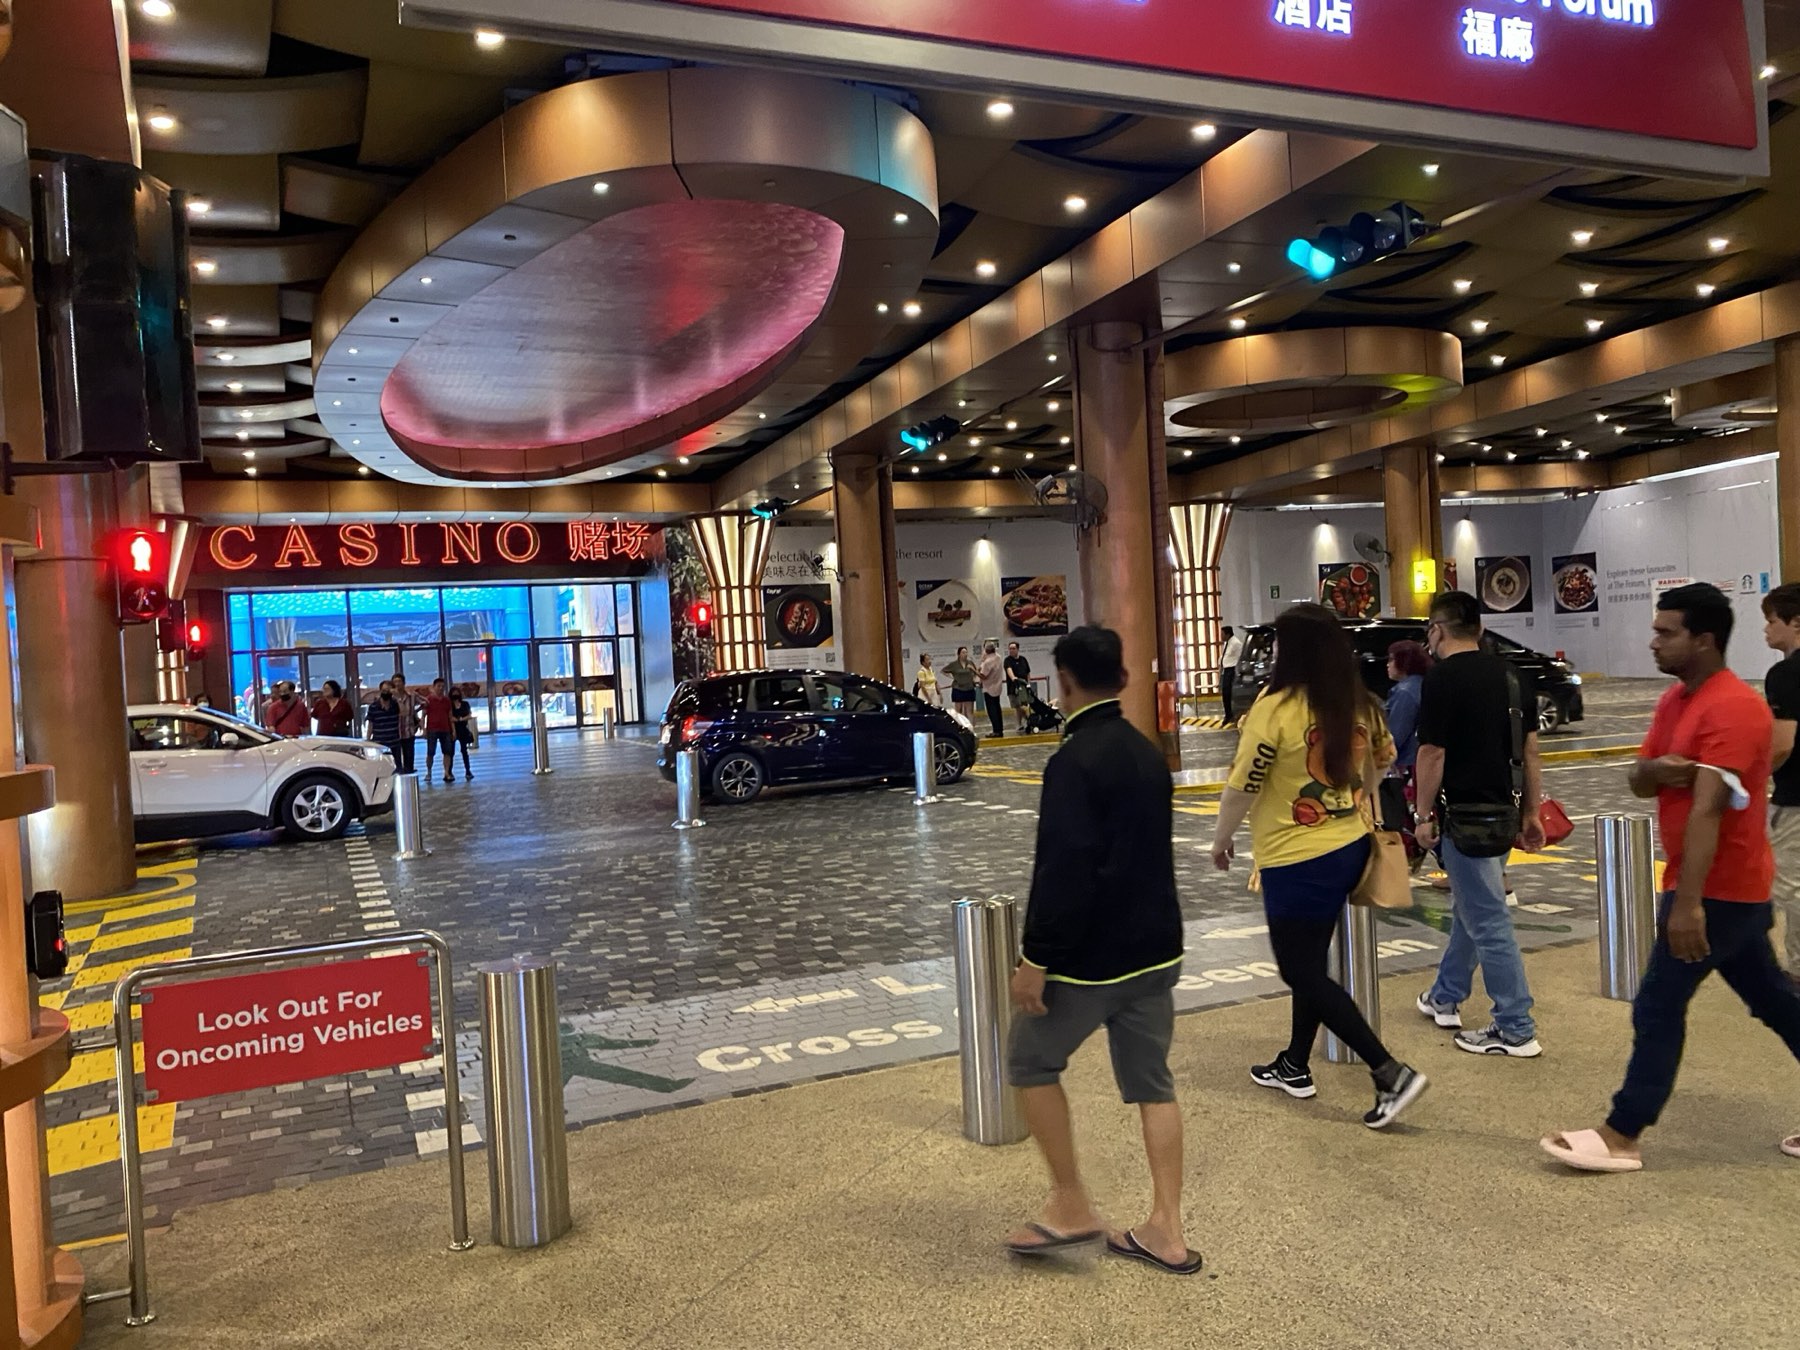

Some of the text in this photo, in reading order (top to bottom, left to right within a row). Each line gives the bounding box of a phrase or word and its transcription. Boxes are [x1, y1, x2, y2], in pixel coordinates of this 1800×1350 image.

[1462, 9, 1534, 62] 福廊
[209, 521, 541, 570] CASINO
[198, 990, 382, 1033] Look Out For
[156, 1014, 423, 1070] Oncoming Vehicles
[696, 1020, 943, 1073] Cross
